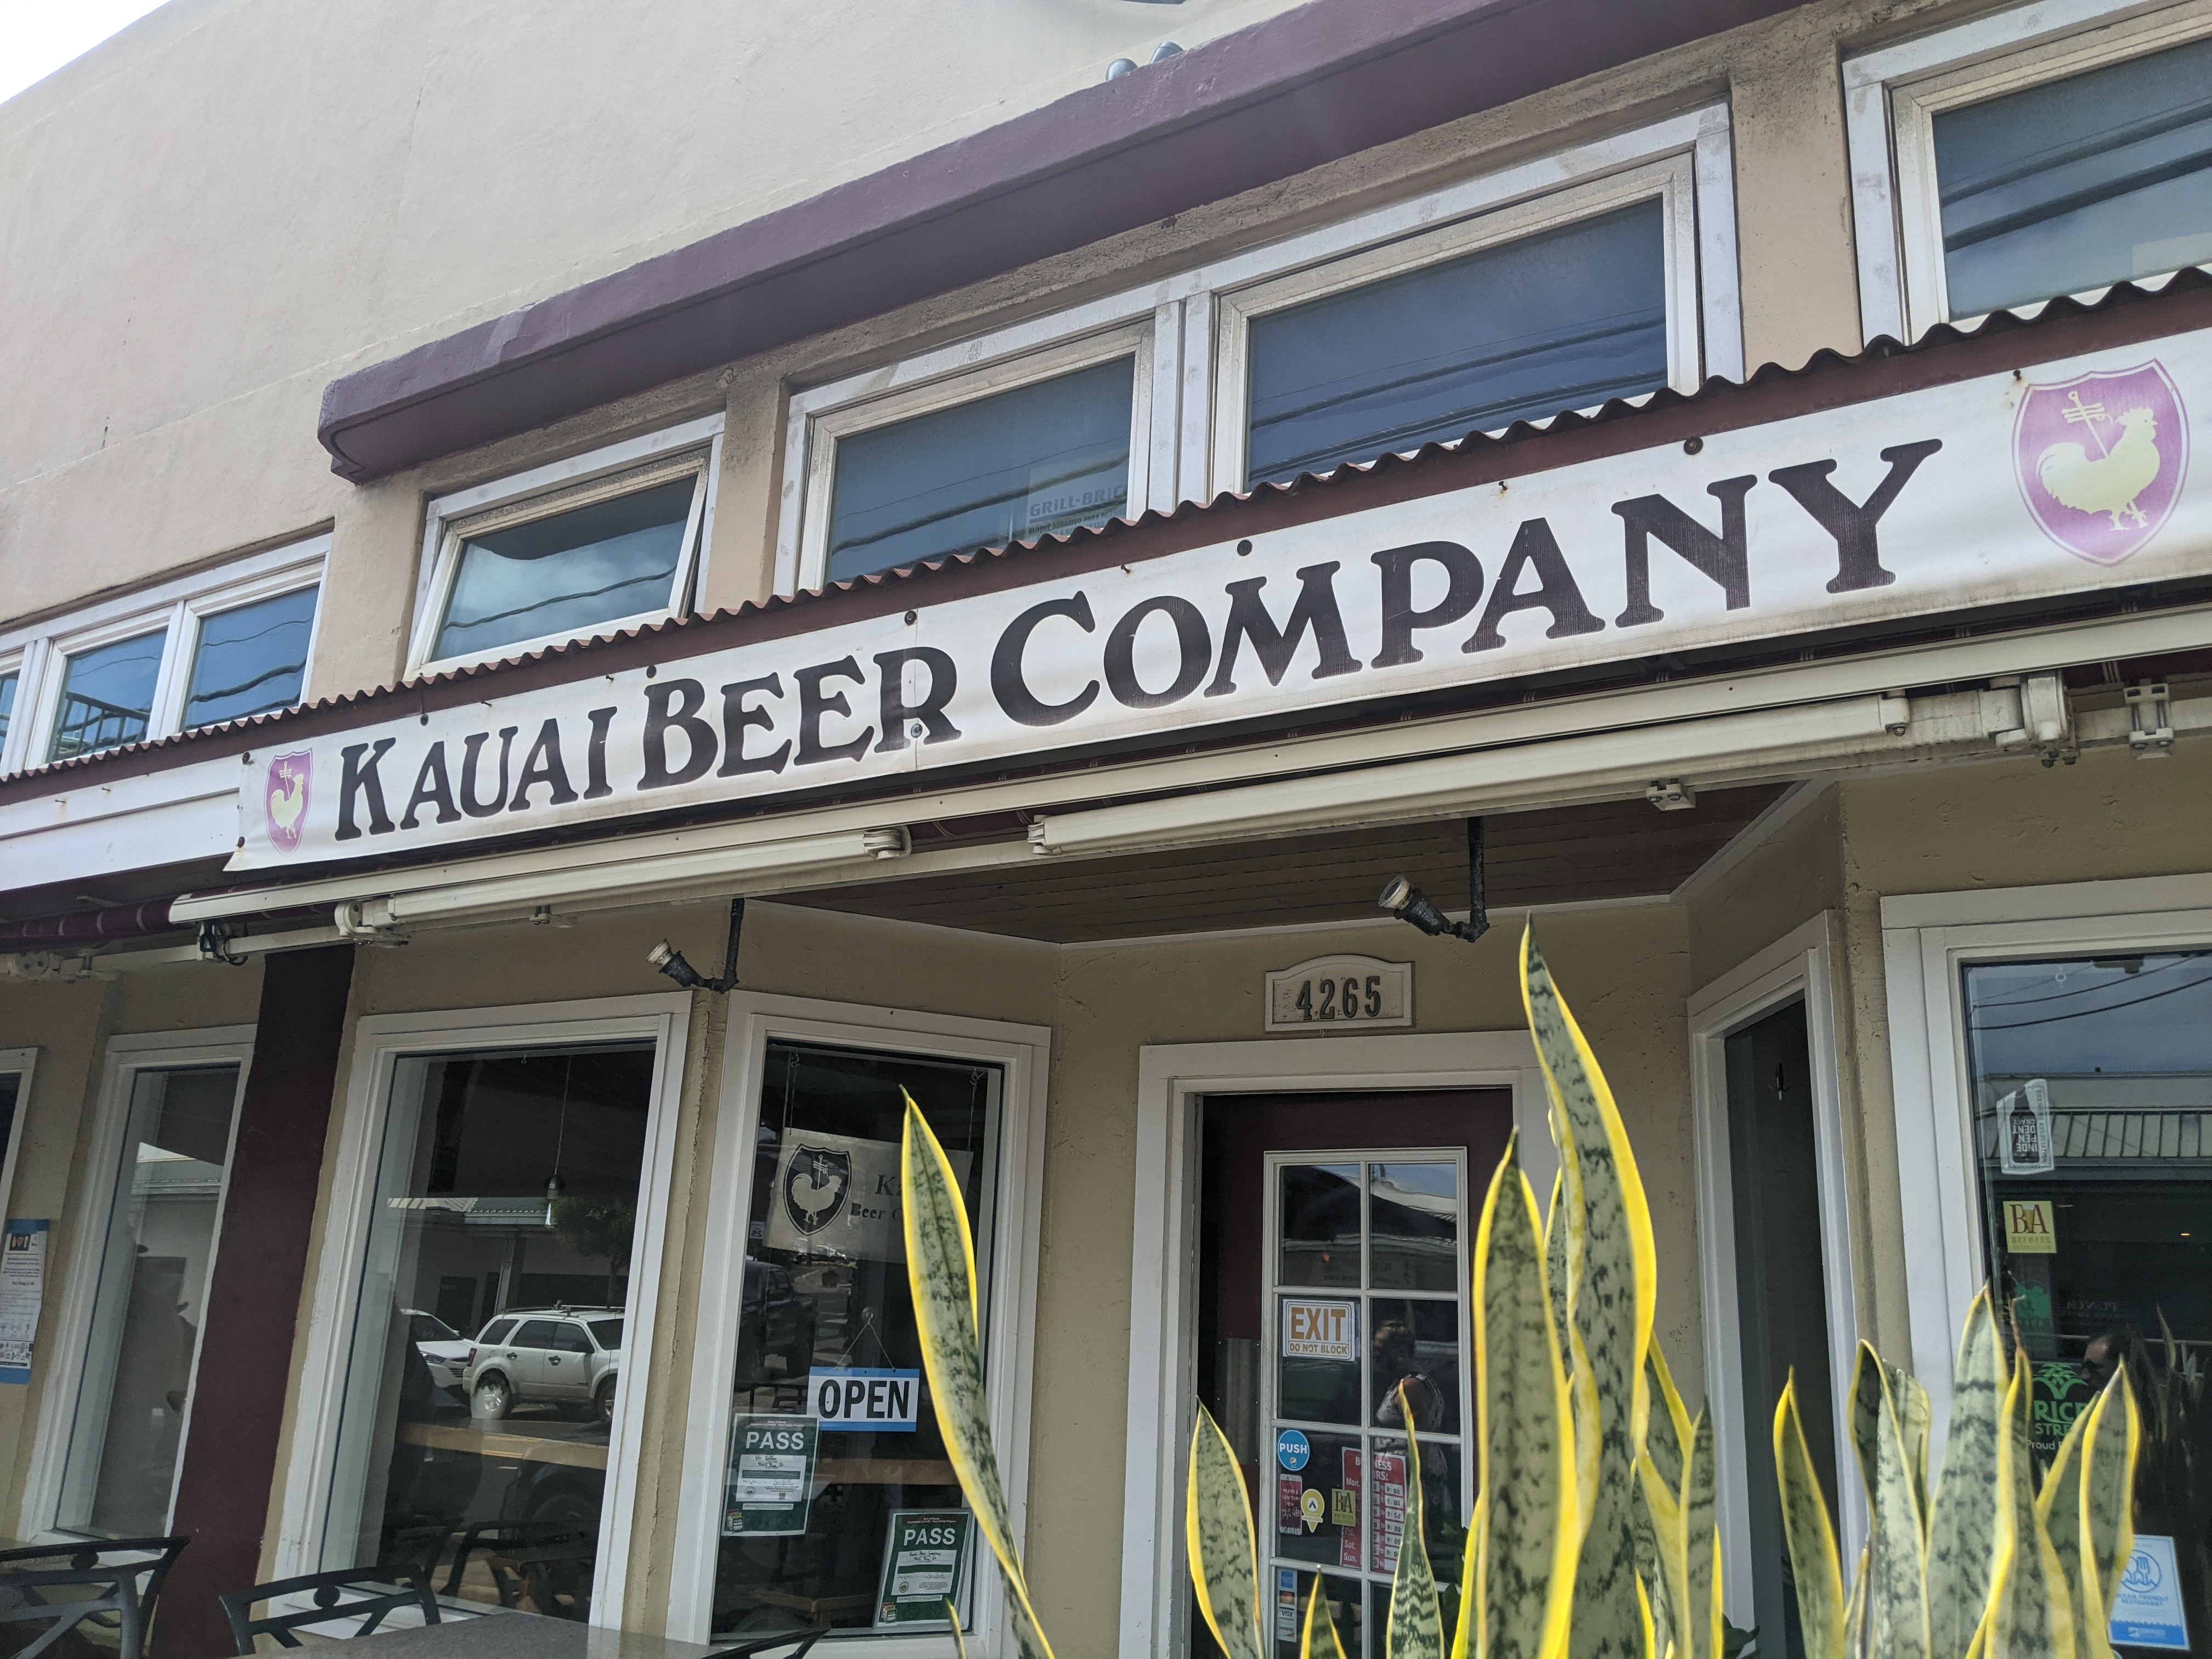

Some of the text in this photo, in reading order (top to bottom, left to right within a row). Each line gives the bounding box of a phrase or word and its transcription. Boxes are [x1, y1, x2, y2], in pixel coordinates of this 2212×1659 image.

[335, 438, 1943, 841] KAUAI BEER COMPANY
[1296, 976, 1381, 1020] 4265
[2012, 1125, 2036, 1134] DENT
[2018, 1135, 2037, 1143] PEN
[2016, 1143, 2038, 1152] INDE
[850, 1203, 886, 1220] Beer
[1291, 1307, 1346, 1341] EXIT
[1290, 1343, 1347, 1355] DO NOT BLOCK
[818, 1379, 910, 1420] OPEN
[746, 1431, 804, 1450] PASS
[1279, 1443, 1307, 1454] PUSH
[1346, 1477, 1361, 1487] Mon.
[903, 1528, 956, 1546] PASS
[1344, 1539, 1356, 1549] Sat.
[1344, 1552, 1357, 1563] Sun.
